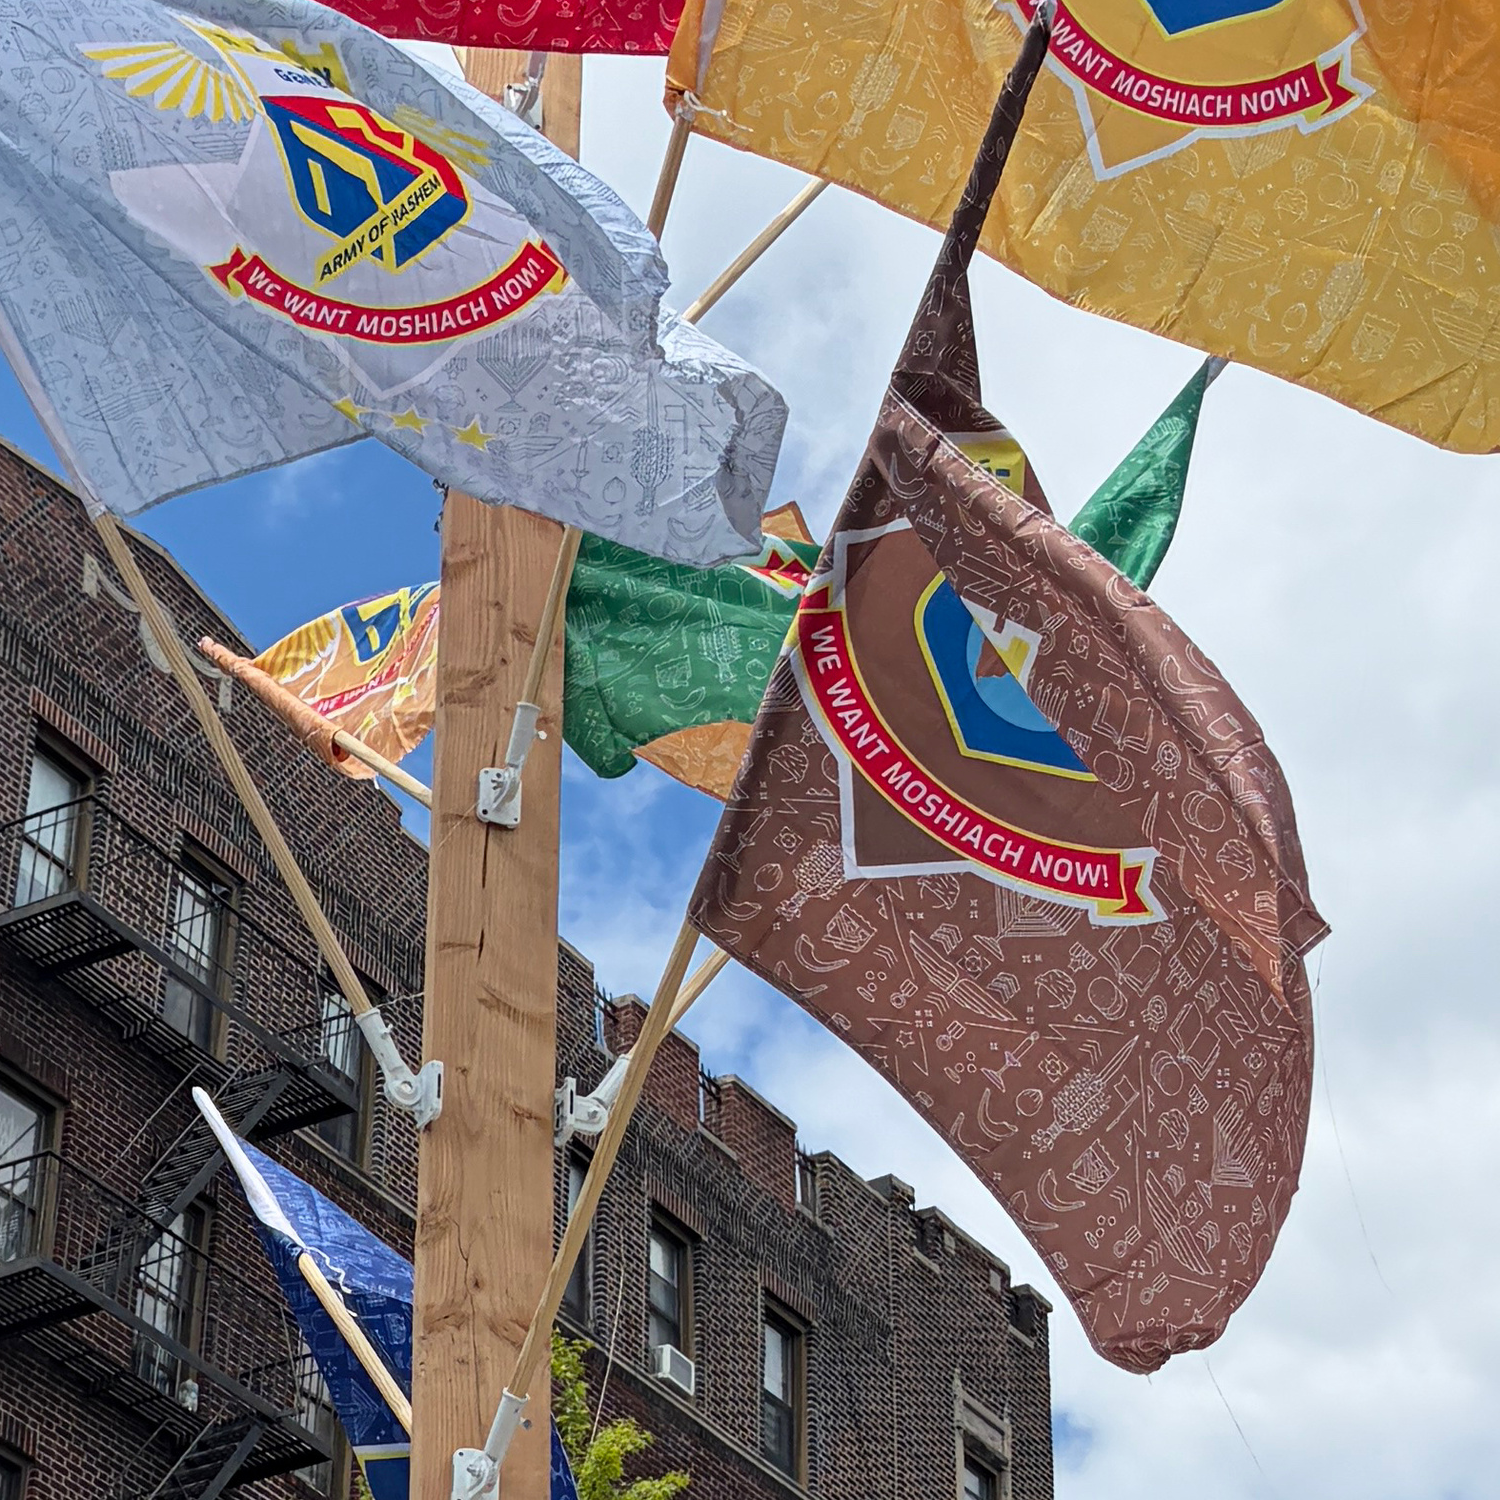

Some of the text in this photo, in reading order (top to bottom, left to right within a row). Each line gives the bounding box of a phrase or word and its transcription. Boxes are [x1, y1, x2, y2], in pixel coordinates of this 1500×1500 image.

[1052, 20, 1113, 82] WANT
[1111, 67, 1232, 119] MOSHIACH
[1240, 77, 1311, 116] NOW!
[320, 175, 443, 282] ARMY OF HASHEM
[284, 293, 352, 330] WANT
[355, 302, 489, 338] MOSHIACH
[494, 259, 546, 311] NOW!
[811, 624, 1110, 889] WE WANT MOSHIACH NOW!
